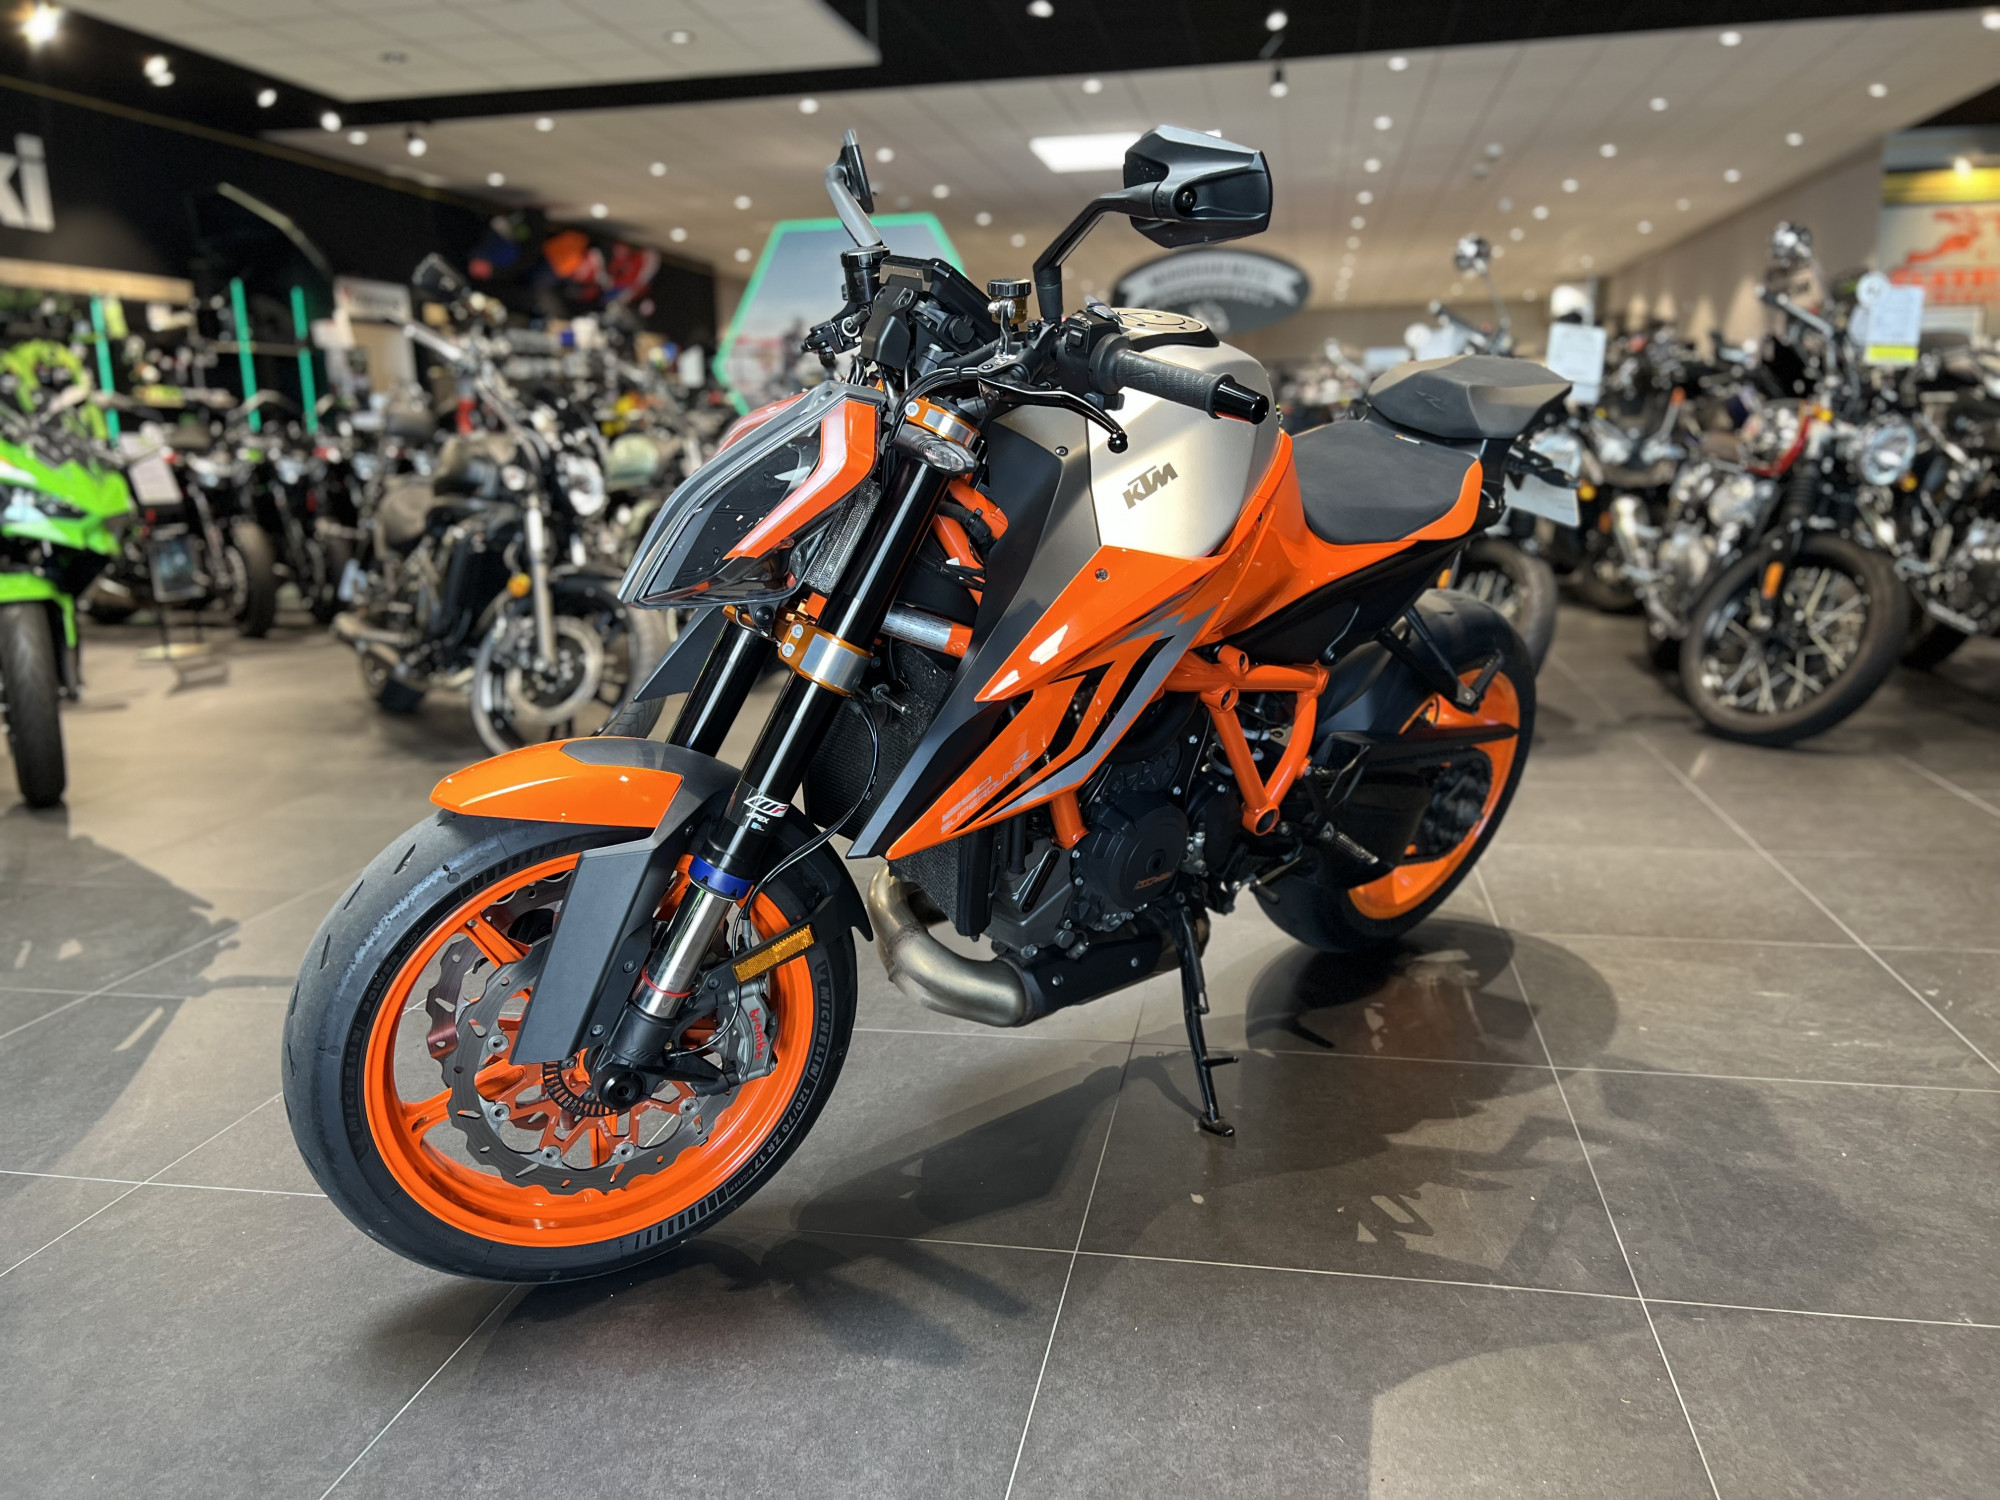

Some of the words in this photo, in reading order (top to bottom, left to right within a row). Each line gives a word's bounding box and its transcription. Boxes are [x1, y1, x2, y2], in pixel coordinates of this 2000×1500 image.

[1122, 461, 1179, 510] KTM
[362, 954, 401, 1013] POWER
[749, 1007, 768, 1060] brembo
[809, 985, 832, 1080] MICHELIN
[344, 1028, 362, 1134] MICHELIN
[781, 1086, 811, 1134] 120/70
[754, 1154, 767, 1170] 17
[766, 1133, 783, 1154] ZR
